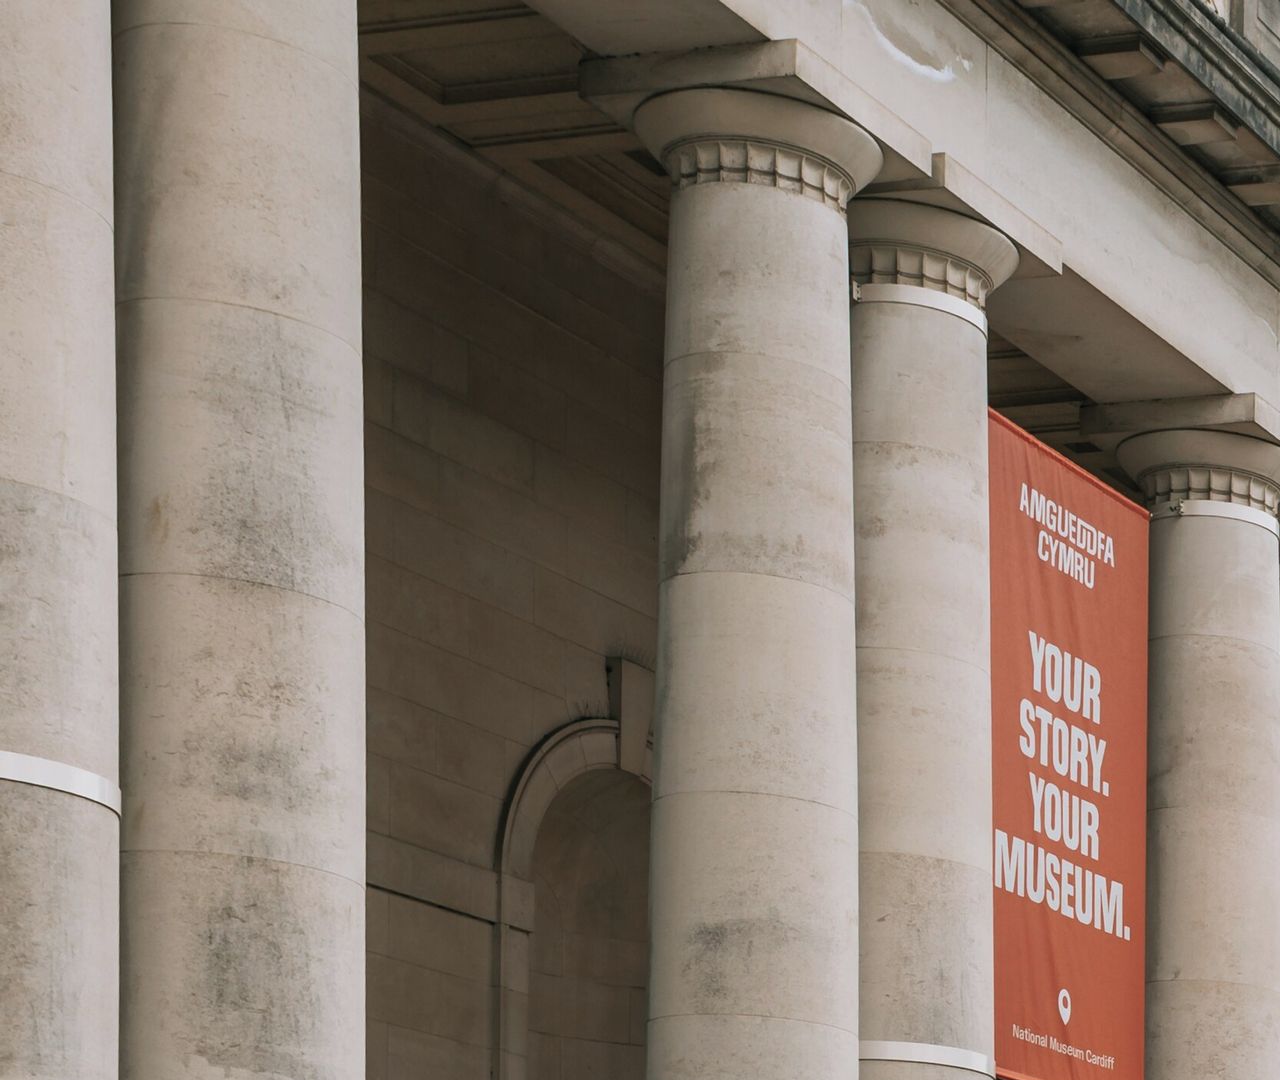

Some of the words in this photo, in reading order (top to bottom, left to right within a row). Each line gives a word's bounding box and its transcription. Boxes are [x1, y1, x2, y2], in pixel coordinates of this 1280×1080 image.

[1019, 482, 1115, 568] AMGUEDDFA
[1037, 530, 1095, 589] CYMRU
[1028, 630, 1101, 724] YOUR
[1019, 698, 1109, 797] STORY.
[1028, 771, 1100, 860] YOUR
[994, 828, 1131, 941] MUSEUM.
[1012, 1023, 1048, 1048] National
[1049, 1036, 1085, 1061] Museum
[1085, 1049, 1115, 1070] Cardiff
